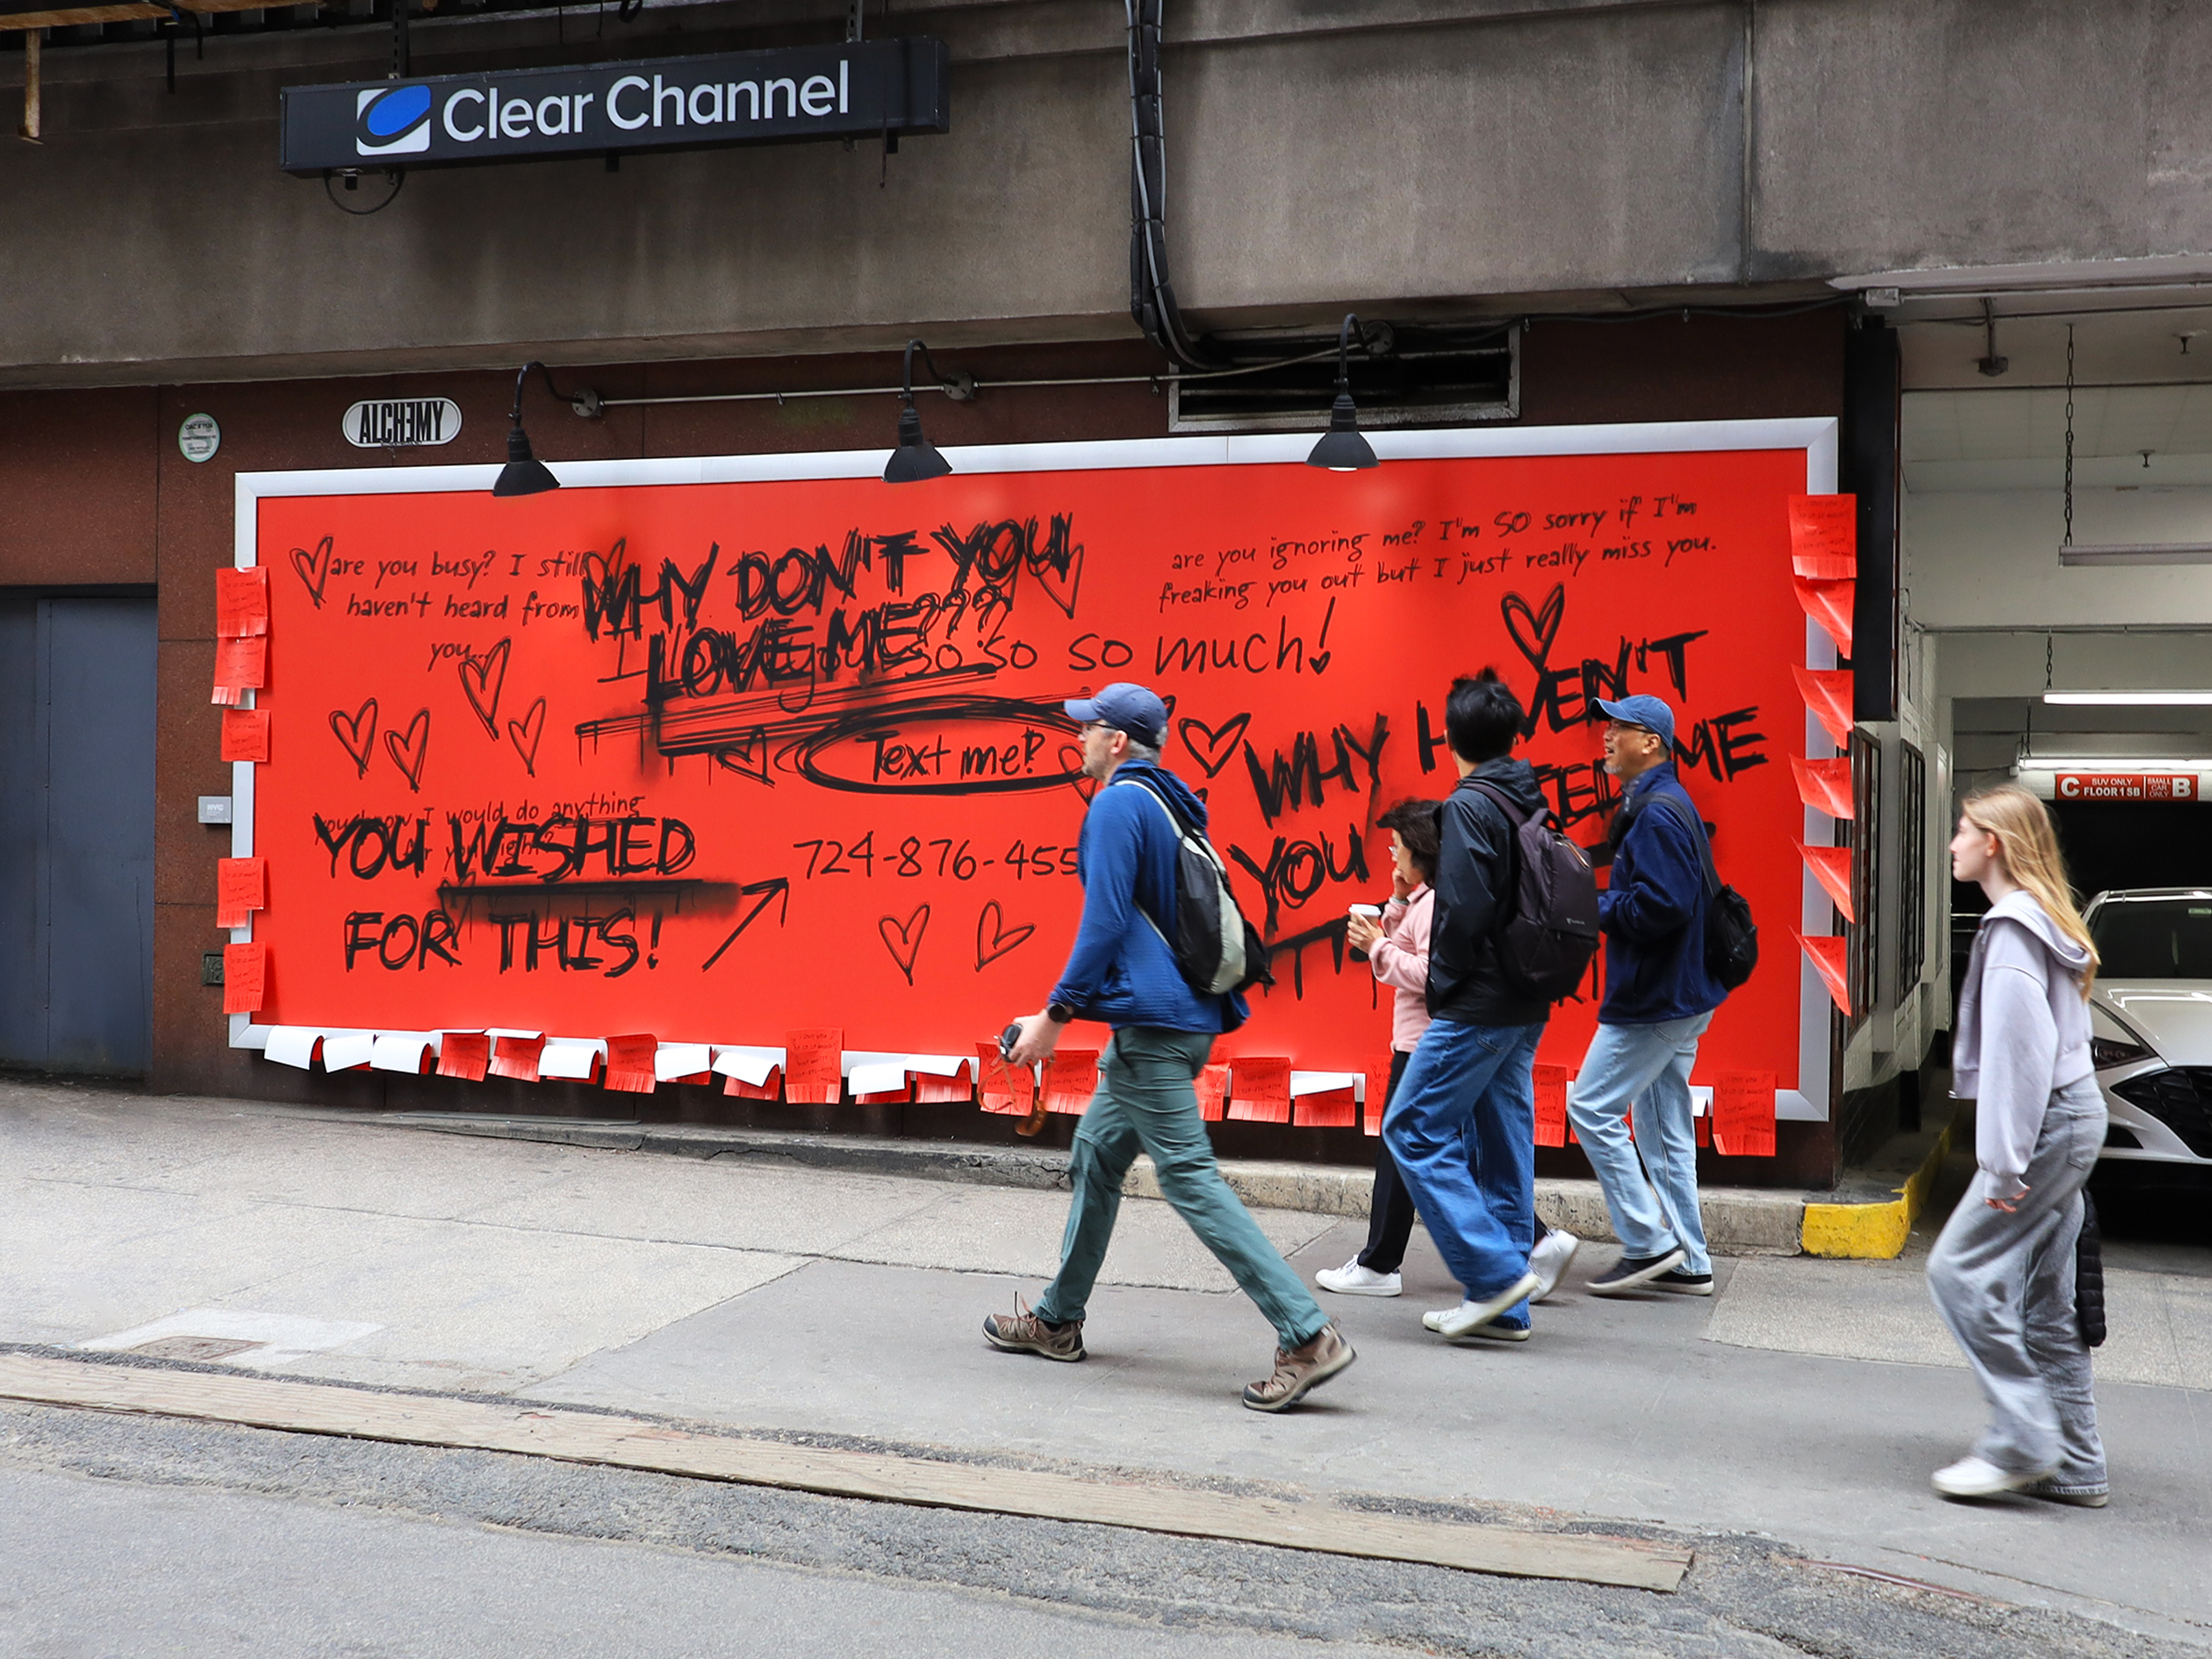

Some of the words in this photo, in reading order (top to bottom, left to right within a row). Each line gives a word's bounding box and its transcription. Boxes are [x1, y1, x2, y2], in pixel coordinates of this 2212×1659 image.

[442, 88, 593, 142] Clear
[606, 61, 850, 132] Channel
[359, 400, 445, 444] ALCHEMY
[330, 555, 364, 577] are
[375, 556, 419, 590] you
[431, 550, 497, 591] busy?
[509, 552, 527, 577] I
[537, 549, 586, 578] still
[1172, 552, 1205, 571] are
[1217, 548, 1256, 577] you
[1268, 529, 1371, 570] ignoring
[1382, 520, 1426, 547] me?
[1439, 515, 1481, 541] I'm
[1544, 505, 1608, 537] sorry
[1619, 496, 1642, 526] if
[1653, 493, 1698, 519] I'm
[347, 591, 434, 618] haven't
[443, 593, 509, 620] heard
[521, 590, 579, 627] from
[581, 540, 720, 645] WHY
[728, 528, 930, 621] DON'T
[930, 511, 1073, 595] YOU
[1159, 580, 1258, 613] freaking
[1267, 576, 1308, 607] you
[1320, 563, 1365, 591] out
[1375, 556, 1422, 585] but
[1433, 556, 1449, 579] I
[1457, 549, 1513, 585] just
[1525, 544, 1591, 577] really
[1601, 535, 1652, 562] miss
[1667, 533, 1718, 567] you.
[642, 617, 815, 704] LOVE
[1154, 596, 1338, 676] much!
[858, 730, 952, 781] Text
[1243, 711, 1390, 830] WHY
[2060, 777, 2080, 797] C
[2172, 778, 2192, 798] B
[446, 800, 505, 826] would
[516, 799, 539, 822] do
[551, 791, 646, 819] anything
[2083, 786, 2117, 797] FLOOR
[312, 811, 427, 880] YOU
[450, 812, 697, 882] WISHED
[794, 830, 1081, 880] 724-876-455
[1225, 822, 1371, 933] YOU
[343, 910, 463, 974] FOR
[488, 908, 664, 979] THIS!
